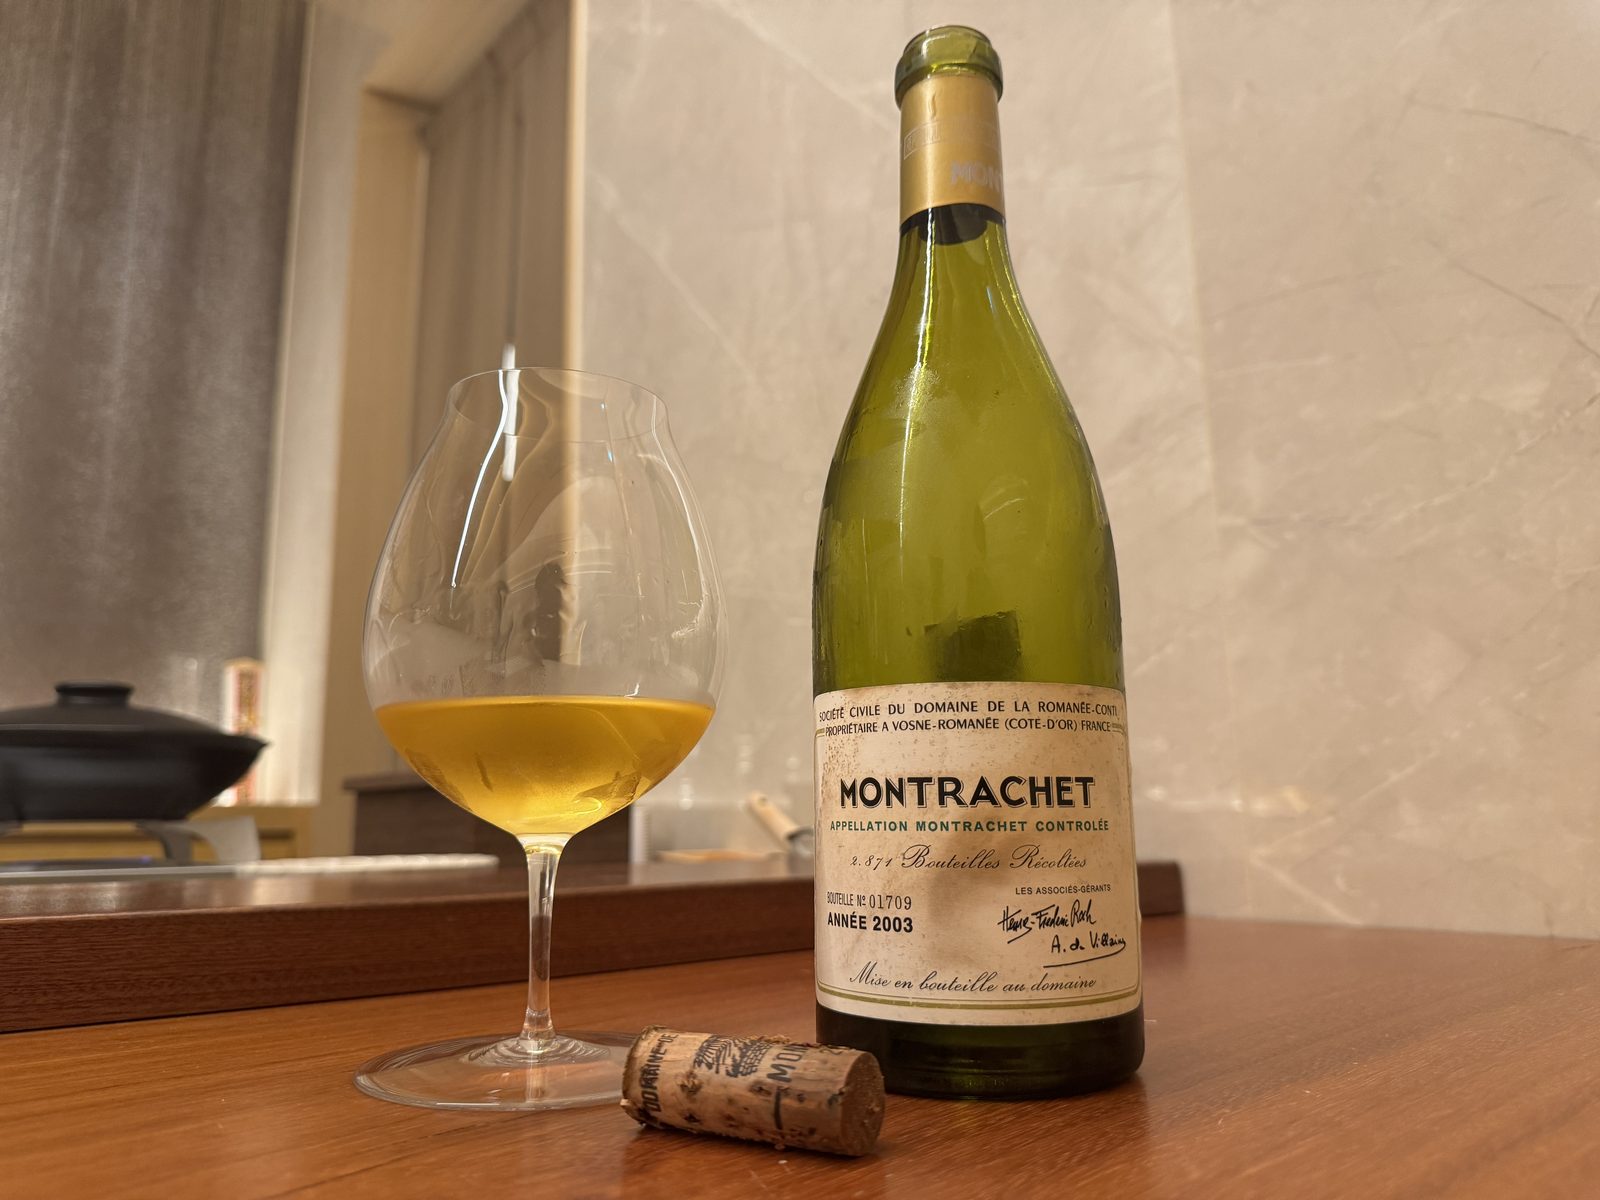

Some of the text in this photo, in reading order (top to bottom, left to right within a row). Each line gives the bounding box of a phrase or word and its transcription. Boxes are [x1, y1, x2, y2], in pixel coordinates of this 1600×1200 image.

[819, 706, 844, 722] SOCIÉTÉ
[849, 704, 880, 717] CIVILE
[888, 703, 905, 715] DU
[914, 700, 978, 714] DOMAINE
[987, 700, 1005, 712] DE
[1014, 700, 1030, 712] LA
[825, 717, 1111, 737] PROPRIÉTAIRE A VOSNE-ROMANÉE (COTE-D'OR) FRANCE
[840, 776, 1095, 808] MONTRACHET
[830, 818, 1109, 832] APPELLATION MONTRACHET CONTROLÉE
[901, 844, 1000, 869] Bouteilles
[1009, 844, 1087, 869] Récoltées
[1015, 884, 1111, 895] LES ASSOCIÉS-GÉRANTS
[827, 891, 854, 906] BOUTEILLE
[869, 894, 912, 911] 01709
[827, 911, 913, 933] ANNÉE 2003
[1050, 934, 1067, 954] A.
[850, 960, 1097, 992] Mise en bouteille au domaine
